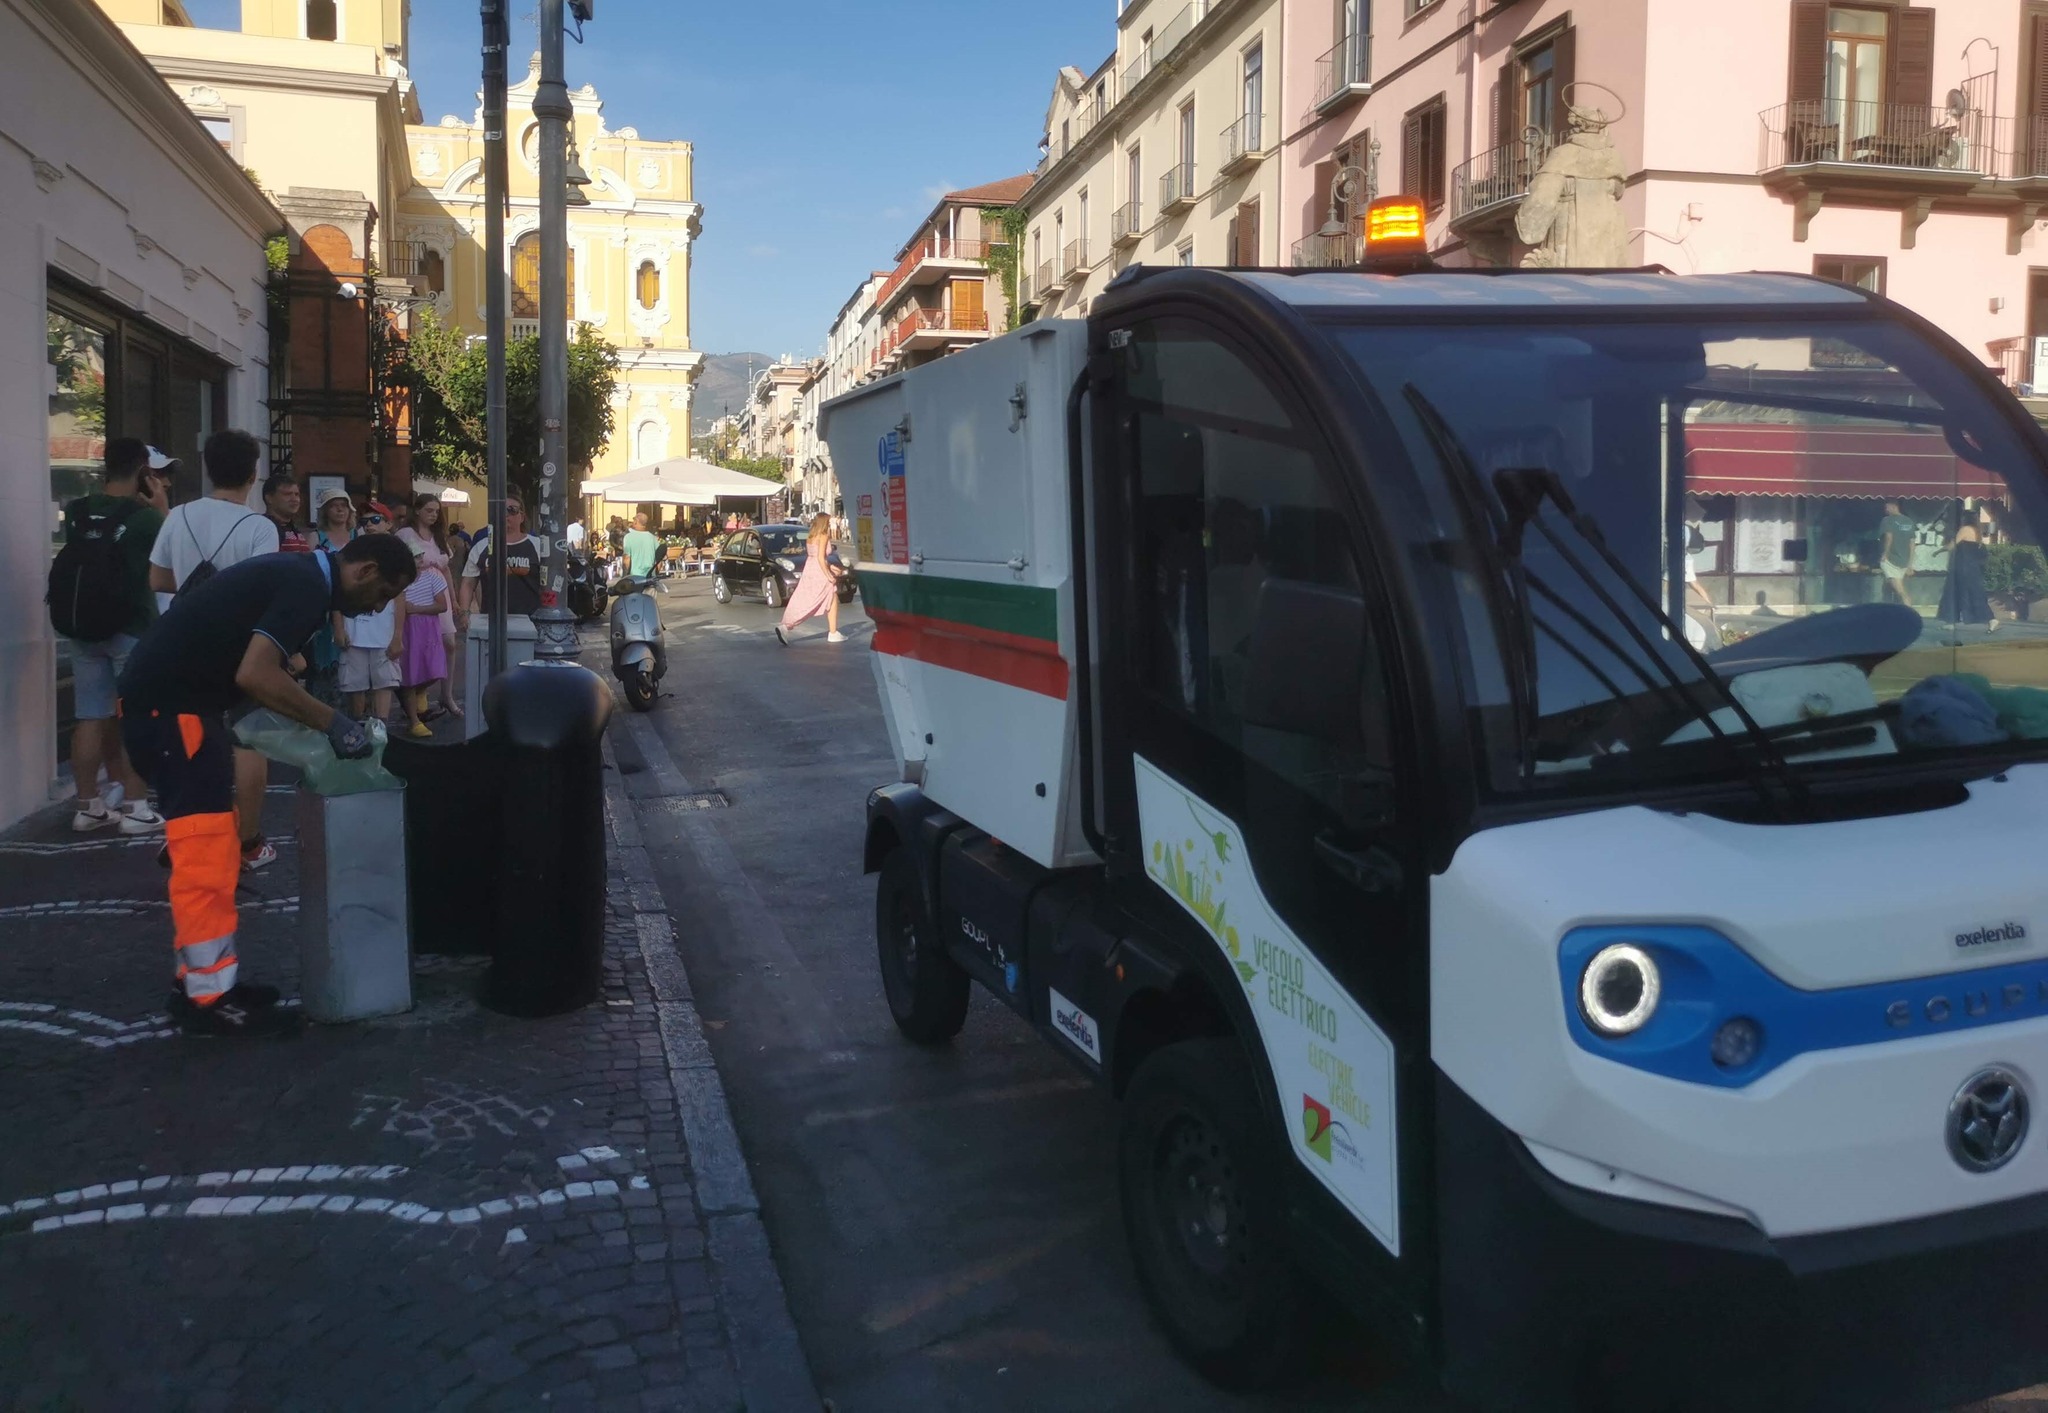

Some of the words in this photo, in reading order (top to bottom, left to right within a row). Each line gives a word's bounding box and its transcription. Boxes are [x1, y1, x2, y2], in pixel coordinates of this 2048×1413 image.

[1253, 933, 1304, 989] VEICOLO
[1955, 922, 2026, 948] exelentia
[1268, 976, 1338, 1044] ELETTRICO
[1308, 1041, 1355, 1090] ELECTRIC
[1329, 1077, 1372, 1130] VEHICLE
